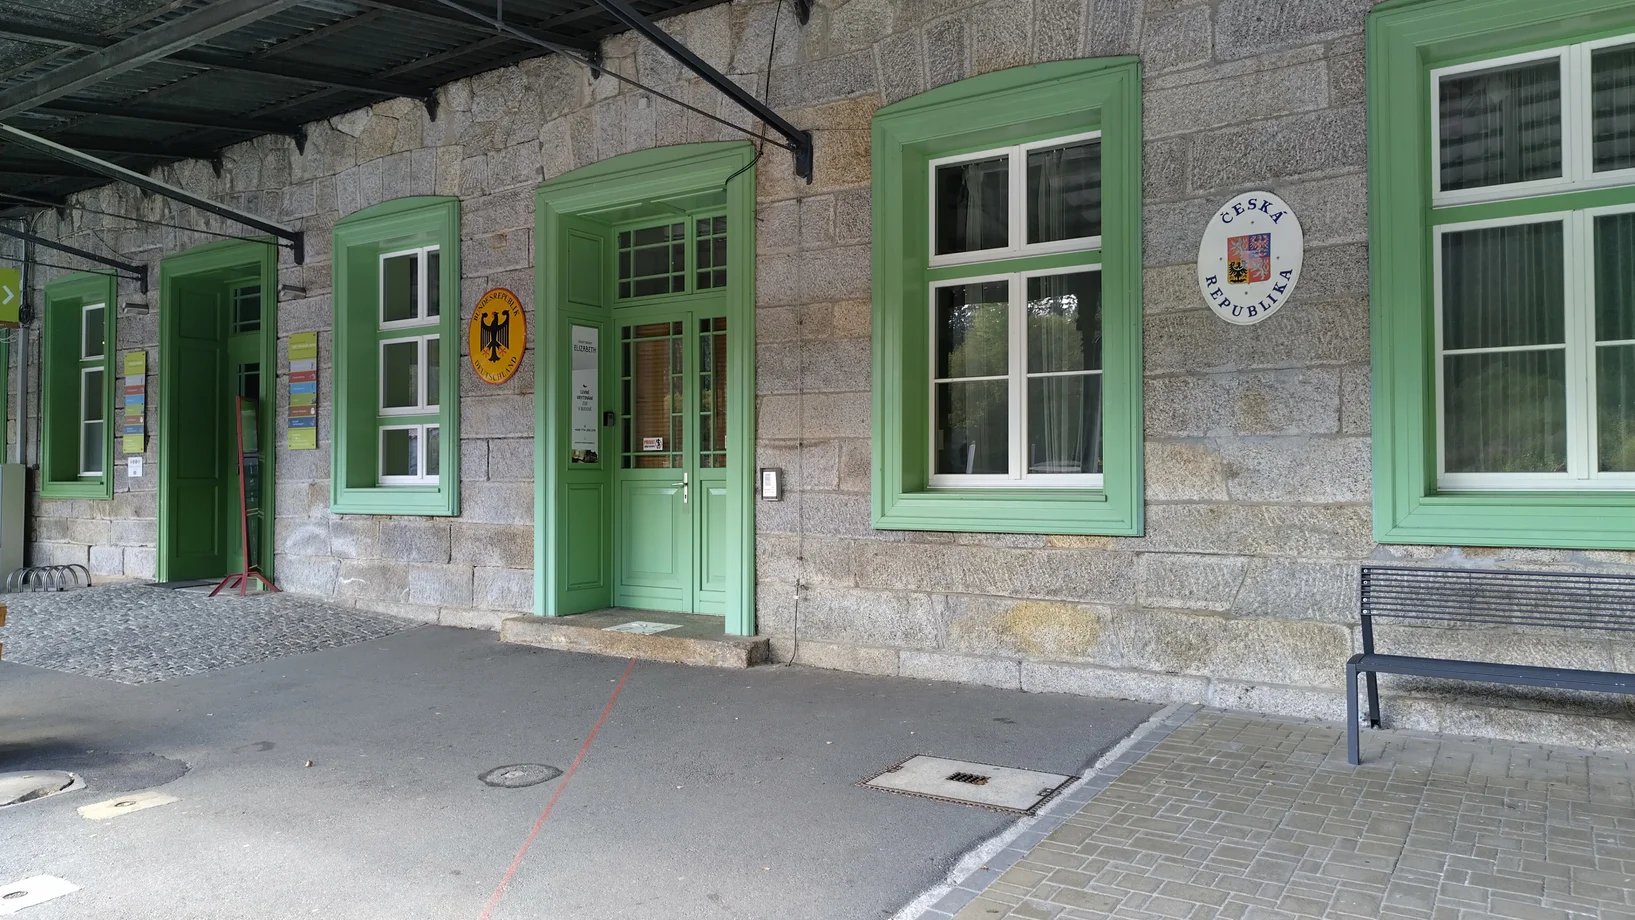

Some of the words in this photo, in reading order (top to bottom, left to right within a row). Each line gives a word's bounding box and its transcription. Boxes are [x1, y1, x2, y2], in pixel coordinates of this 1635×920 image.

[1220, 198, 1287, 224] ČESKÁ
[1206, 268, 1293, 317] REPUBLIKA
[473, 291, 519, 321] BUNDESREPUBLIK
[573, 344, 597, 354] ELIZABETH
[474, 356, 517, 381] DEUTSCHLAND
